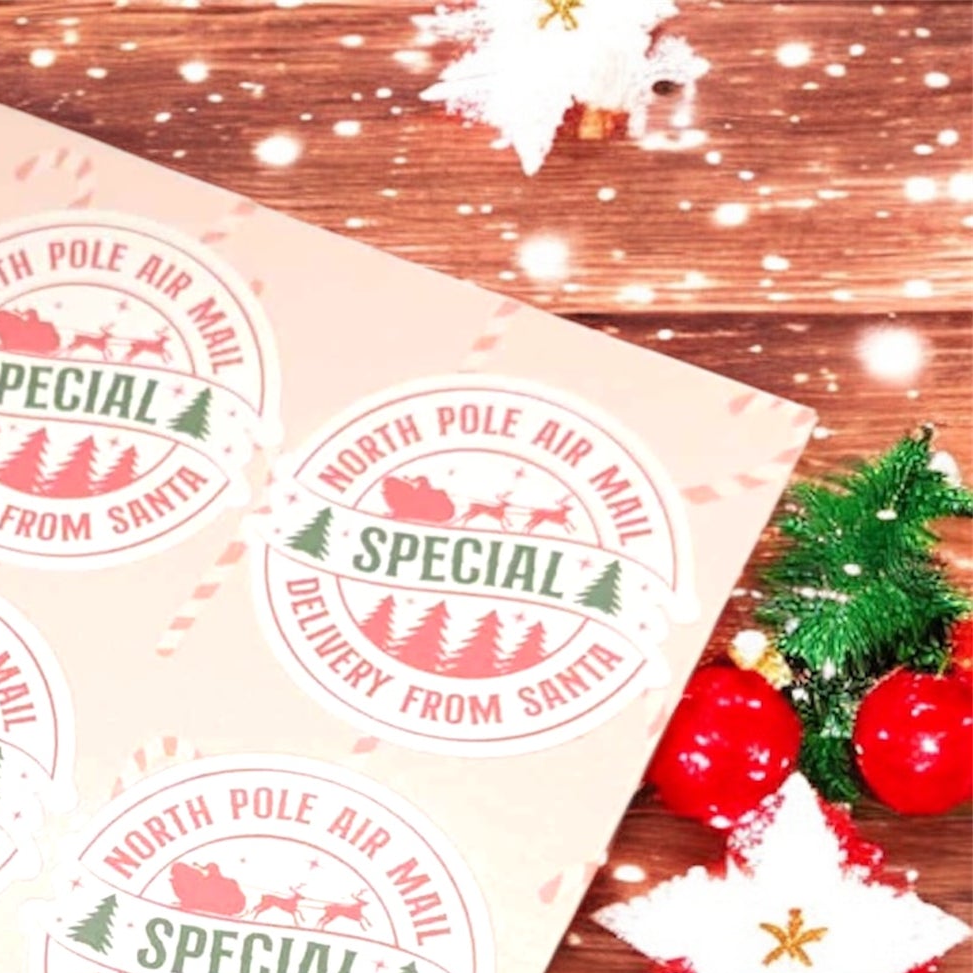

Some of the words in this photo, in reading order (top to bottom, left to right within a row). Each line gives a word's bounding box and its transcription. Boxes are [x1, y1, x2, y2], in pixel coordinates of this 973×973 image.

[49, 239, 128, 271] POLE
[136, 254, 194, 301] AIR
[188, 296, 245, 374] MAIL
[108, 466, 208, 534] SANTA
[318, 415, 422, 494] NORTH
[437, 404, 522, 438] POLE
[531, 419, 593, 468] AIR
[589, 465, 652, 546] MAIL
[352, 526, 564, 599] SPECIAL
[287, 577, 394, 697] DELIVERY
[399, 684, 502, 725] FROM
[518, 643, 624, 717] SANTA
[103, 795, 213, 879] NORTH
[230, 787, 318, 824] POLE
[327, 806, 391, 859] AIR
[386, 857, 452, 946] MAIL
